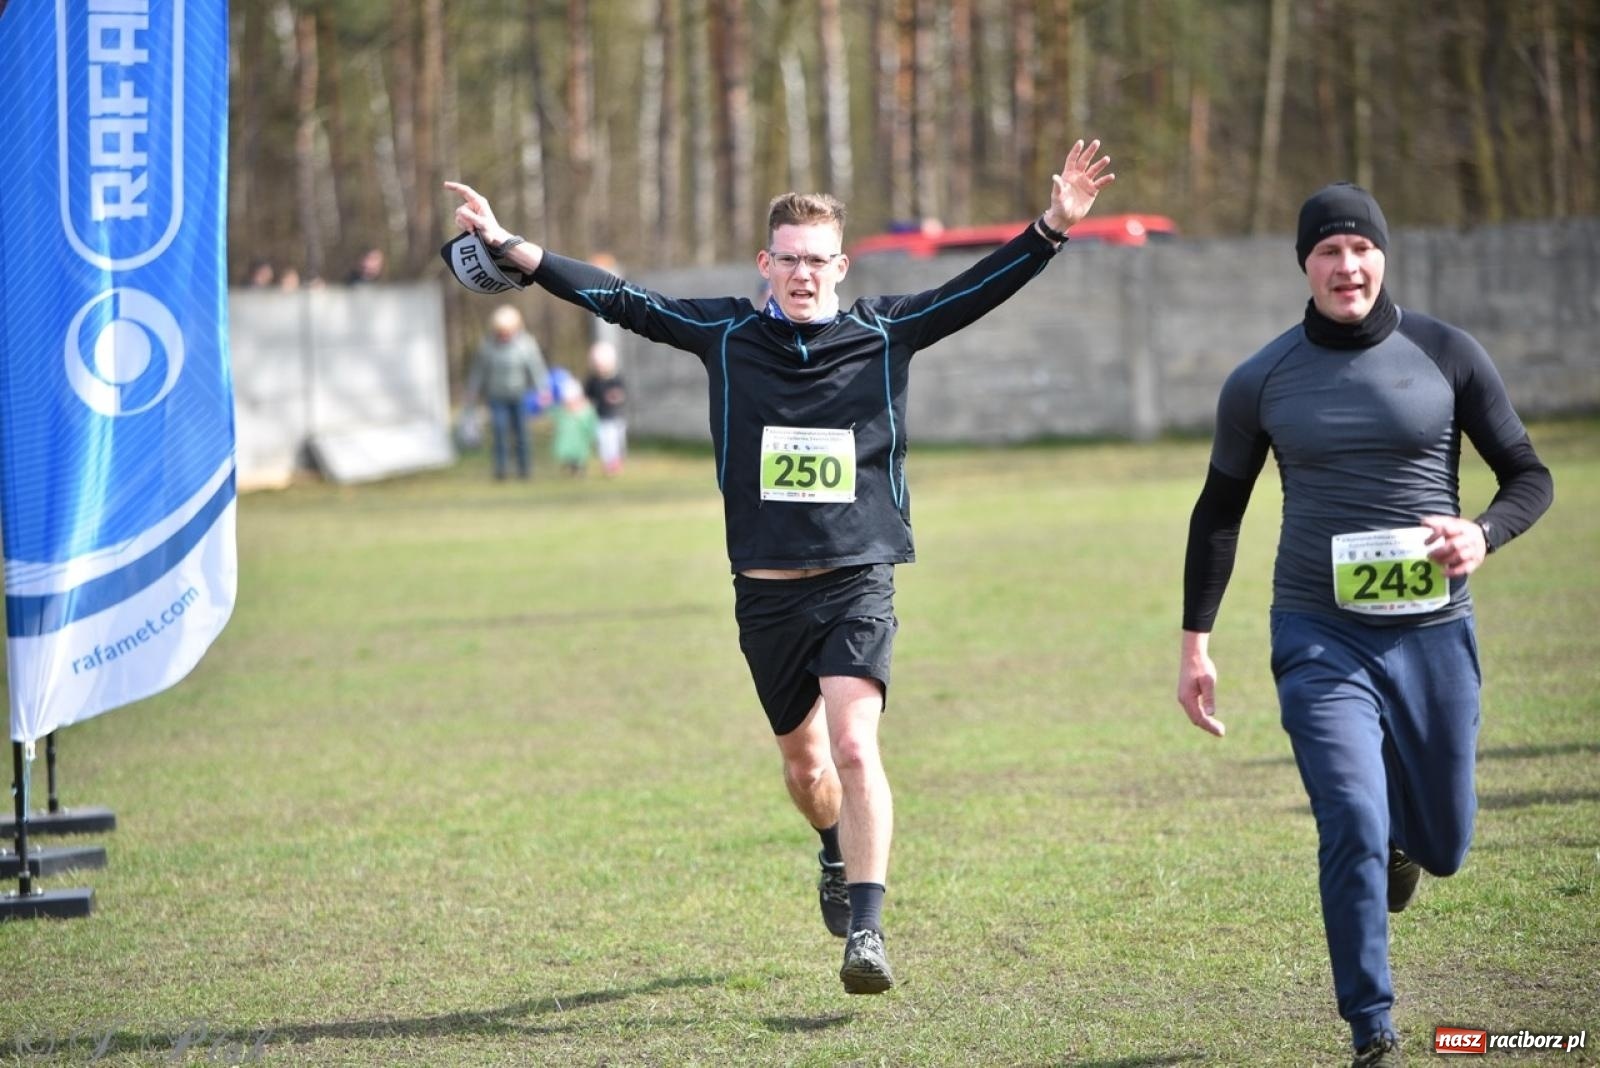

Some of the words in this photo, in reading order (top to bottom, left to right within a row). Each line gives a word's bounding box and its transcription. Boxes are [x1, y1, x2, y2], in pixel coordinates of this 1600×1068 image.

[88, 0, 149, 221] RAFA
[459, 244, 508, 291] DETROIT
[774, 455, 842, 489] 250
[1352, 560, 1434, 600] 243
[71, 586, 200, 675] rafamet.com
